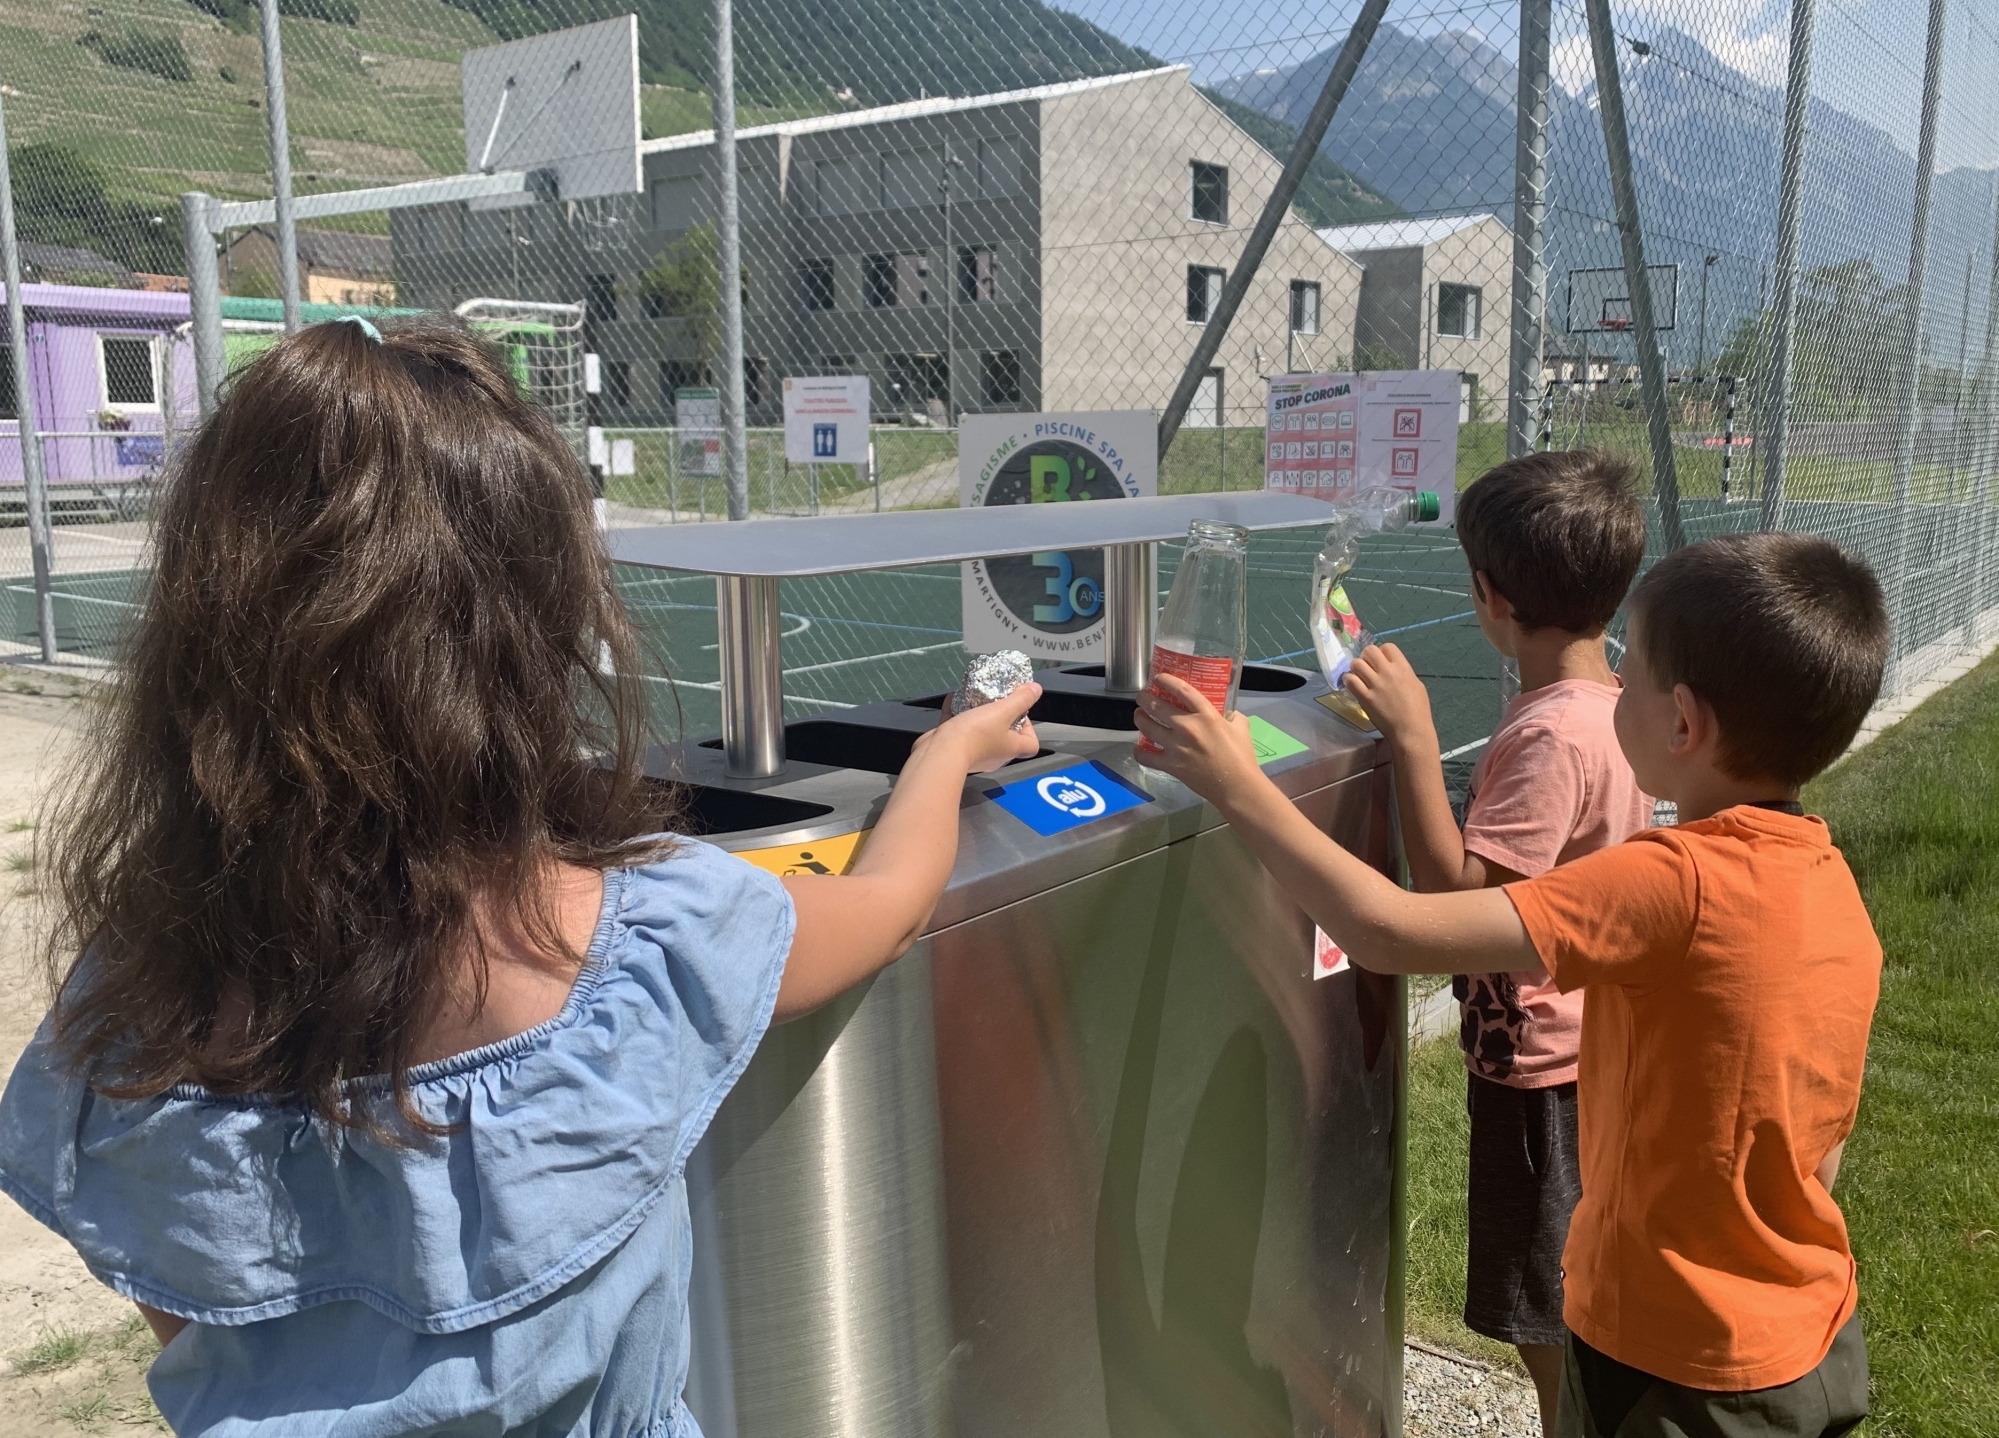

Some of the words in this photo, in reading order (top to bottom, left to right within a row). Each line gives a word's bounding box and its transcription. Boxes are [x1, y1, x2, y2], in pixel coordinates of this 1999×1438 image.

[1275, 394, 1303, 410] STOP
[1304, 383, 1351, 404] CORONA
[1035, 422, 1096, 445] PISCINE
[1098, 441, 1124, 471] SPA
[970, 435, 1018, 507] SAGISME
[971, 561, 1018, 633] MARTIGNY
[1080, 591, 1105, 602] ANS
[1058, 789, 1089, 805] alu
